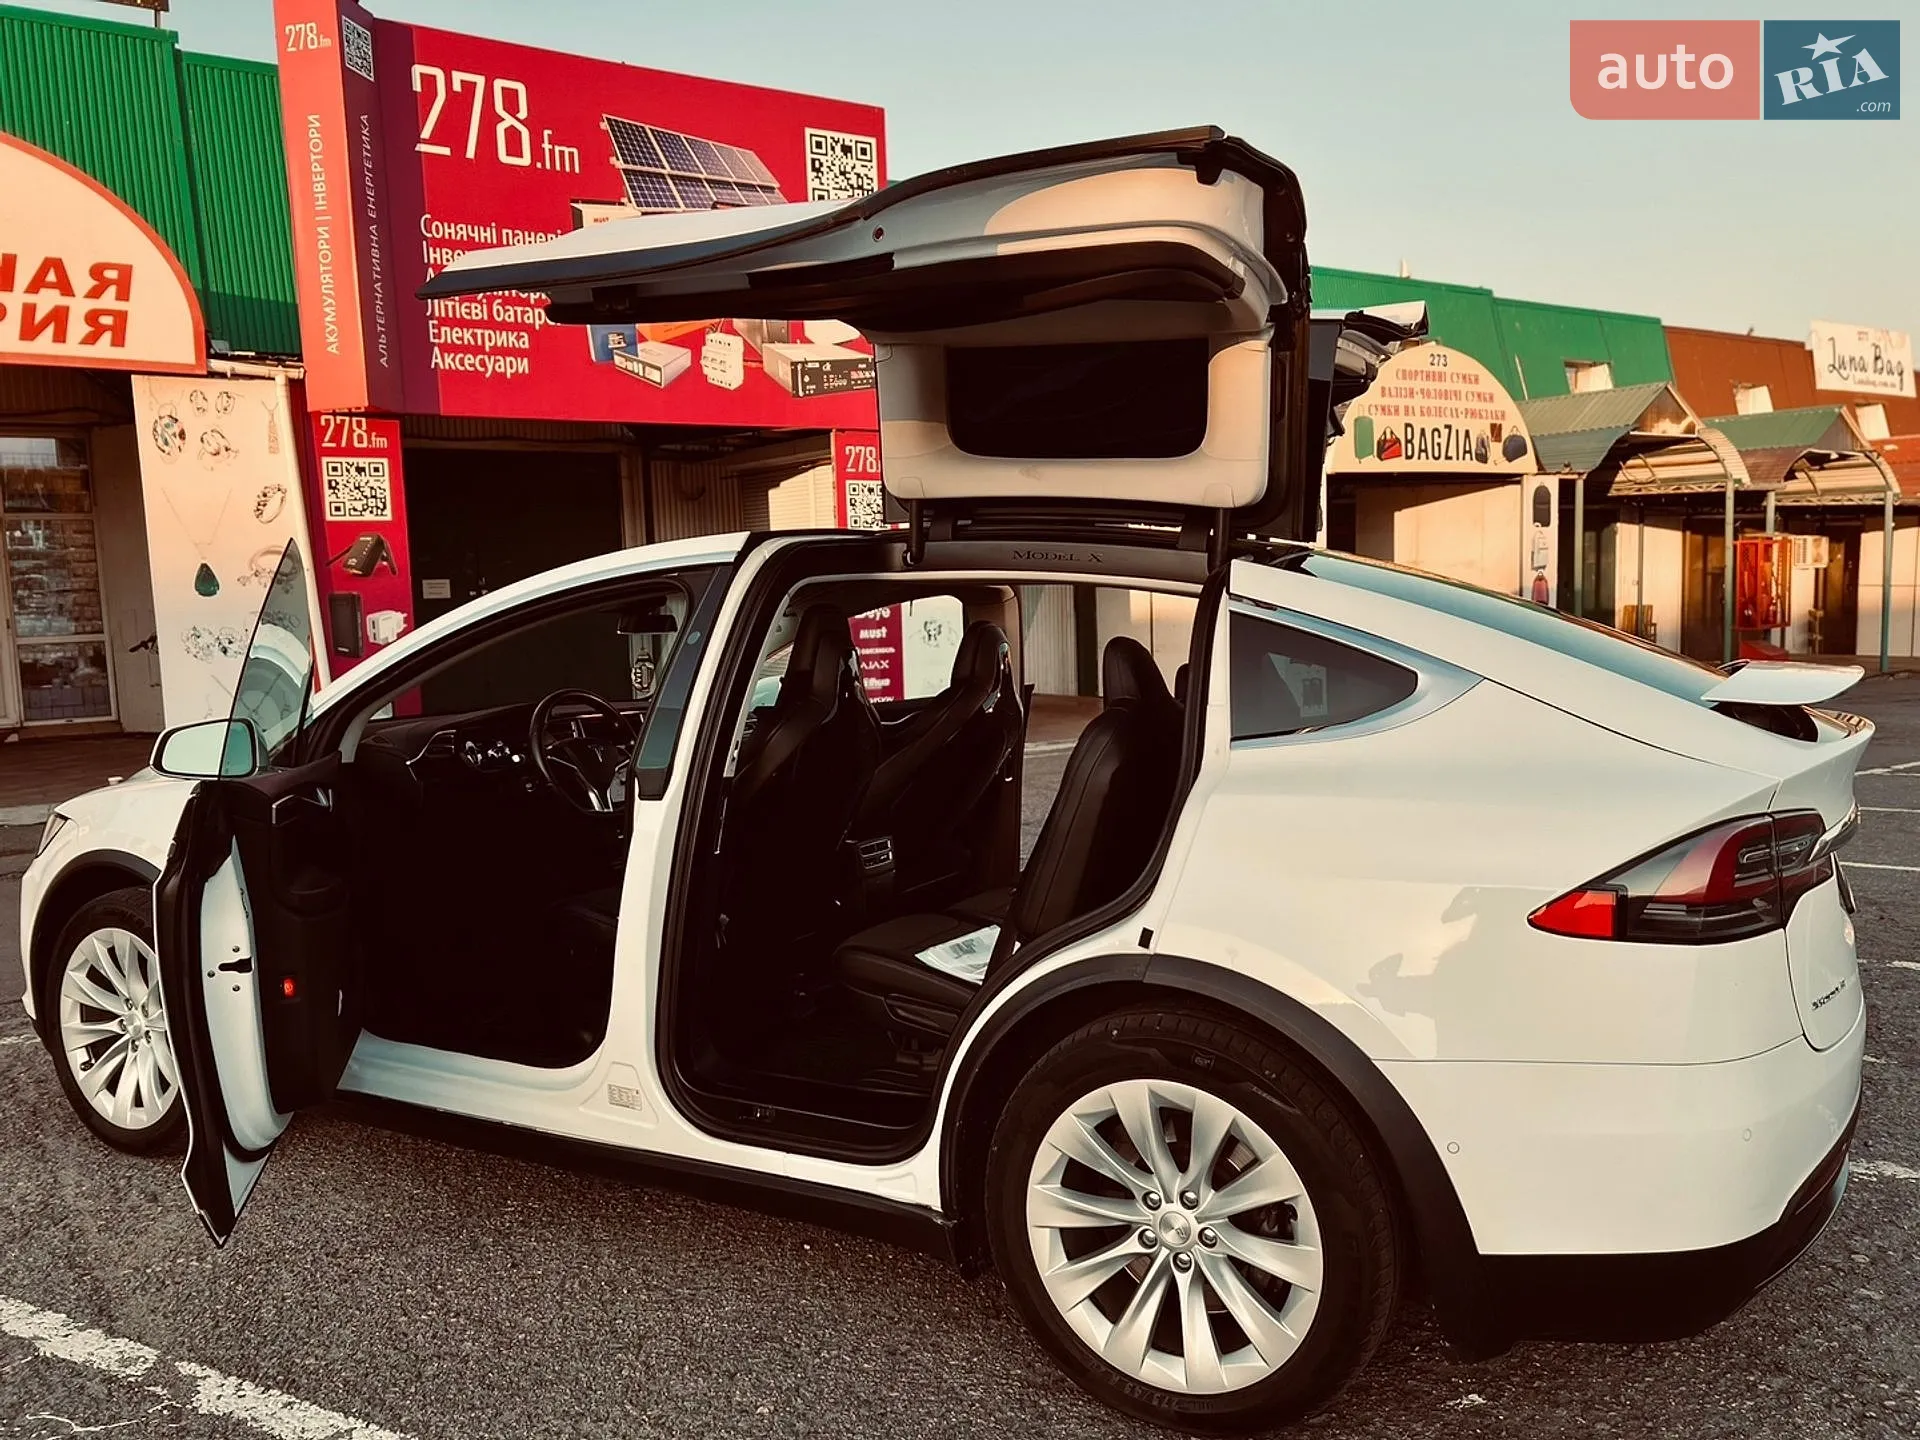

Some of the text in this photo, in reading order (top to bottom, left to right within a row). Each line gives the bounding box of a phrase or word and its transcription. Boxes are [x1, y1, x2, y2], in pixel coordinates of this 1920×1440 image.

[285, 22, 332, 52] 278.fm
[411, 63, 580, 174] 278.fm
[307, 114, 340, 356] АКУМУЛЯТОРИ ІНВЕРТОРИ
[360, 114, 390, 369] АЛЬТЕРНАТИВНА ЕНЕРГЕТИКА
[420, 213, 497, 245] Сонячні
[426, 294, 488, 321] Літієві
[0, 302, 128, 348] ИЯ
[429, 320, 530, 352] Електрика
[431, 346, 530, 379] Аксесуари
[1429, 353, 1448, 367] 273
[1827, 336, 1905, 392] Luna Bag
[1396, 369, 1480, 385] СПОРТИВНІ СУМКИ
[1367, 404, 1400, 417] СУМКИ
[1404, 404, 1416, 417] НА
[1465, 390, 1495, 404] СУМКИ
[320, 415, 388, 449] 278.fm
[1012, 550, 1103, 563] MODEL X
